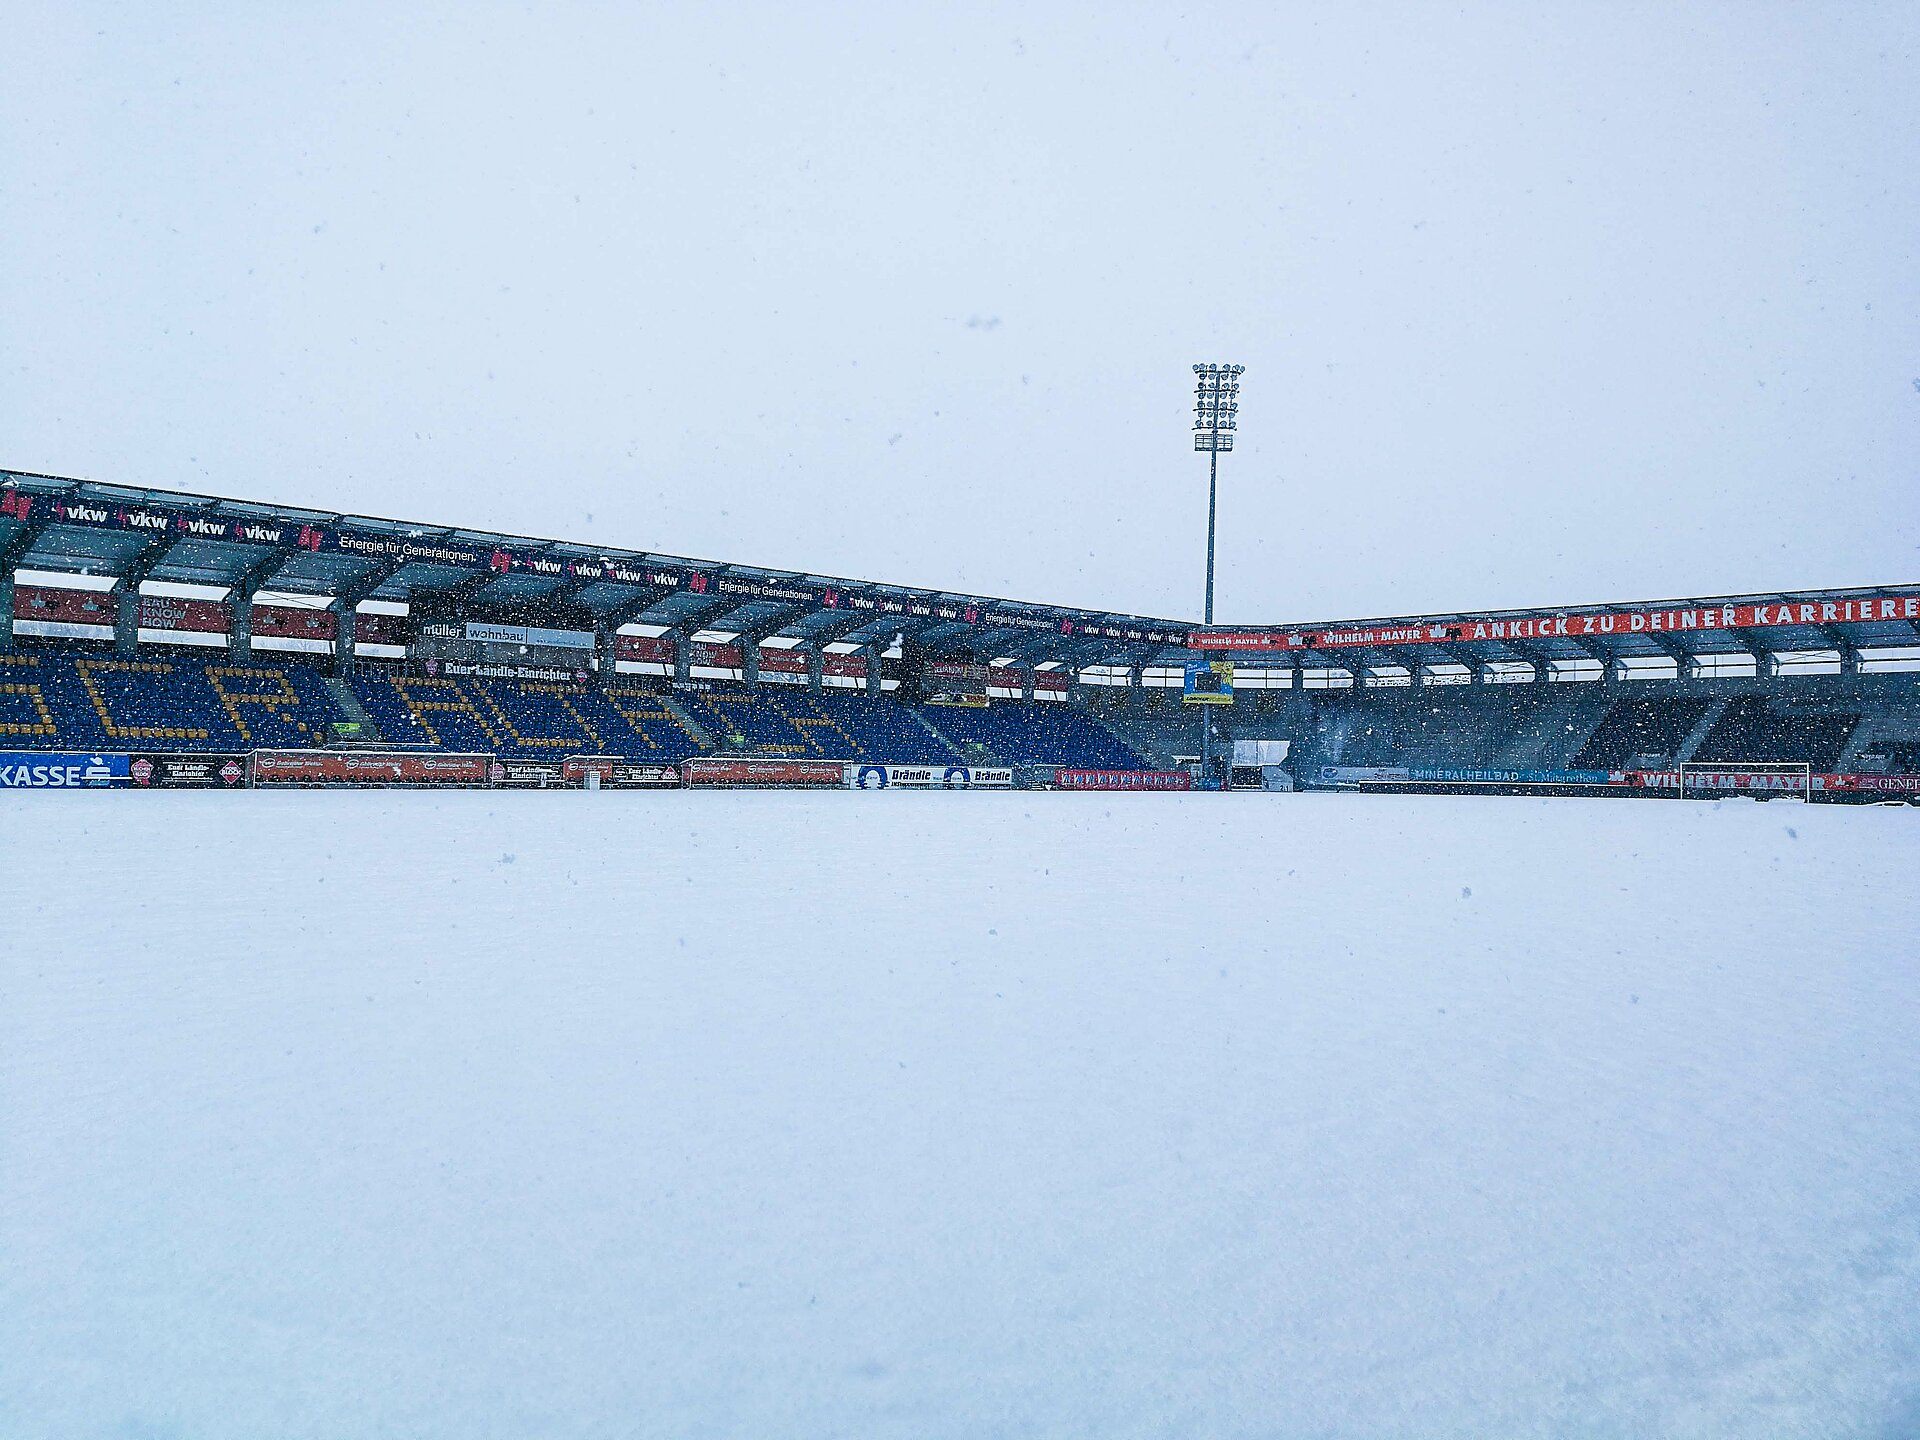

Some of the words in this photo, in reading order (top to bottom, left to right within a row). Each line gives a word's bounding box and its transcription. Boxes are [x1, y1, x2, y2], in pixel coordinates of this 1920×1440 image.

[67, 505, 107, 522] vkw
[130, 512, 168, 530] vkw
[188, 519, 226, 535] vkw
[245, 526, 281, 541] vkw
[340, 536, 384, 552] Energie
[386, 541, 401, 553] für
[533, 559, 561, 573] vkw
[575, 564, 602, 577] vkw
[616, 569, 641, 582] vkw
[654, 573, 678, 586] vkw
[719, 581, 749, 595] Energie
[854, 597, 874, 609] vkw
[884, 600, 902, 612] vkw
[912, 604, 930, 615] vkw
[143, 608, 186, 619] KNOW
[939, 607, 957, 618] vkw
[1474, 617, 1569, 638] ANKICK
[1584, 616, 1614, 633] ZU
[1630, 608, 1736, 630] DEINER
[1754, 599, 1918, 624] KARRIERE
[142, 617, 176, 628] HOW
[423, 624, 462, 638] müller
[469, 628, 524, 641] wohnbau
[1084, 624, 1099, 635] vkw
[1106, 627, 1121, 637] vkw
[1127, 630, 1142, 639] vkw
[1148, 632, 1162, 641] vkw
[1324, 631, 1374, 644] WILHELM
[1381, 629, 1422, 642] MAYER
[445, 662, 471, 675] Euer
[975, 771, 1010, 781] Brändle
[1414, 768, 1519, 781] MINERALHEILBAD
